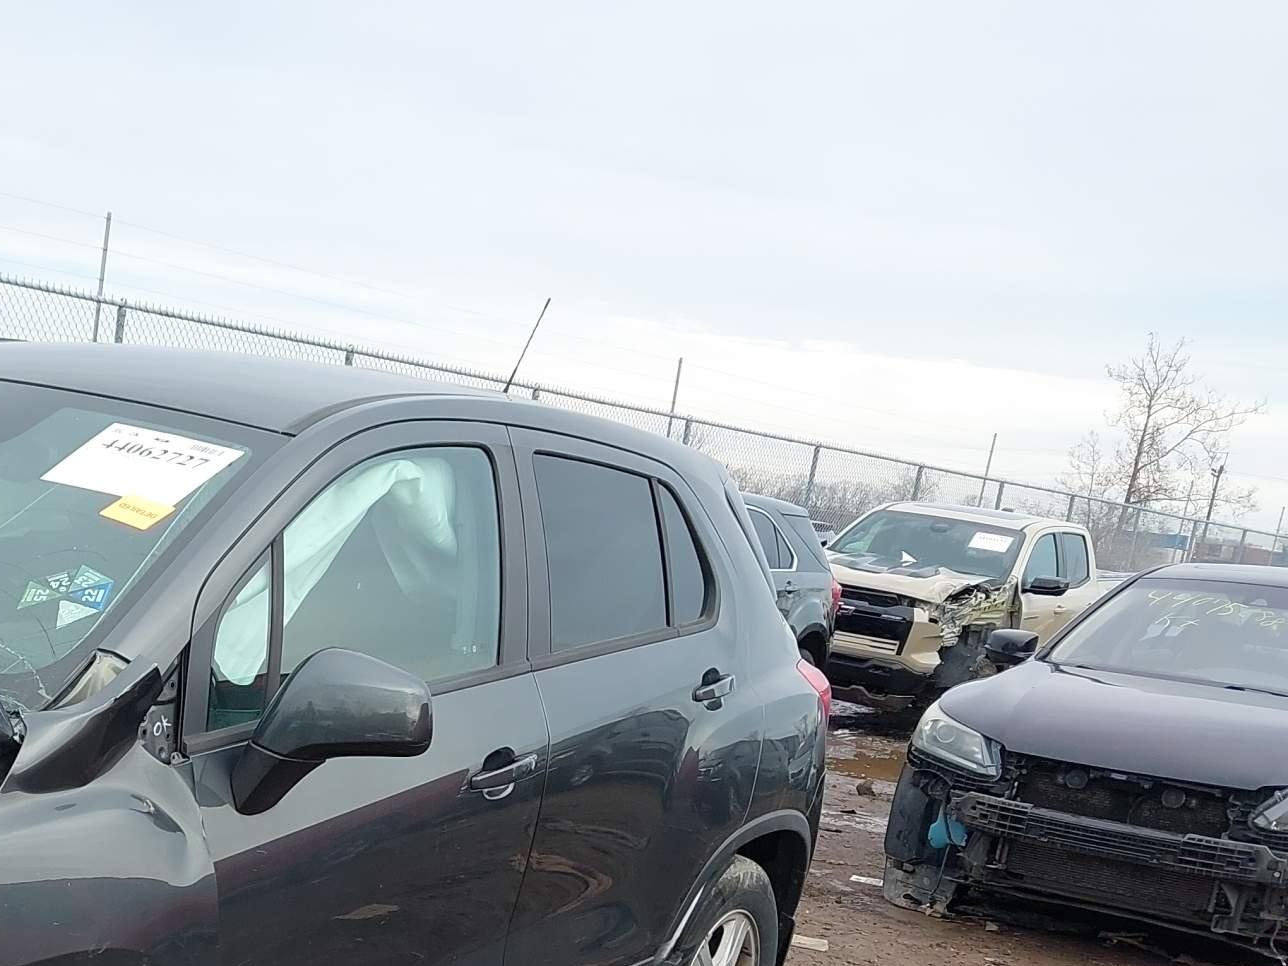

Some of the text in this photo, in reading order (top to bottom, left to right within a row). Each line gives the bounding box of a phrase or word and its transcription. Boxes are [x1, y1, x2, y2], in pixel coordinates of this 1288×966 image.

[102, 439, 210, 469] 44062727
[50, 576, 72, 590] 24
[74, 574, 96, 588] 23
[33, 588, 50, 602] 25
[81, 588, 98, 602] 22
